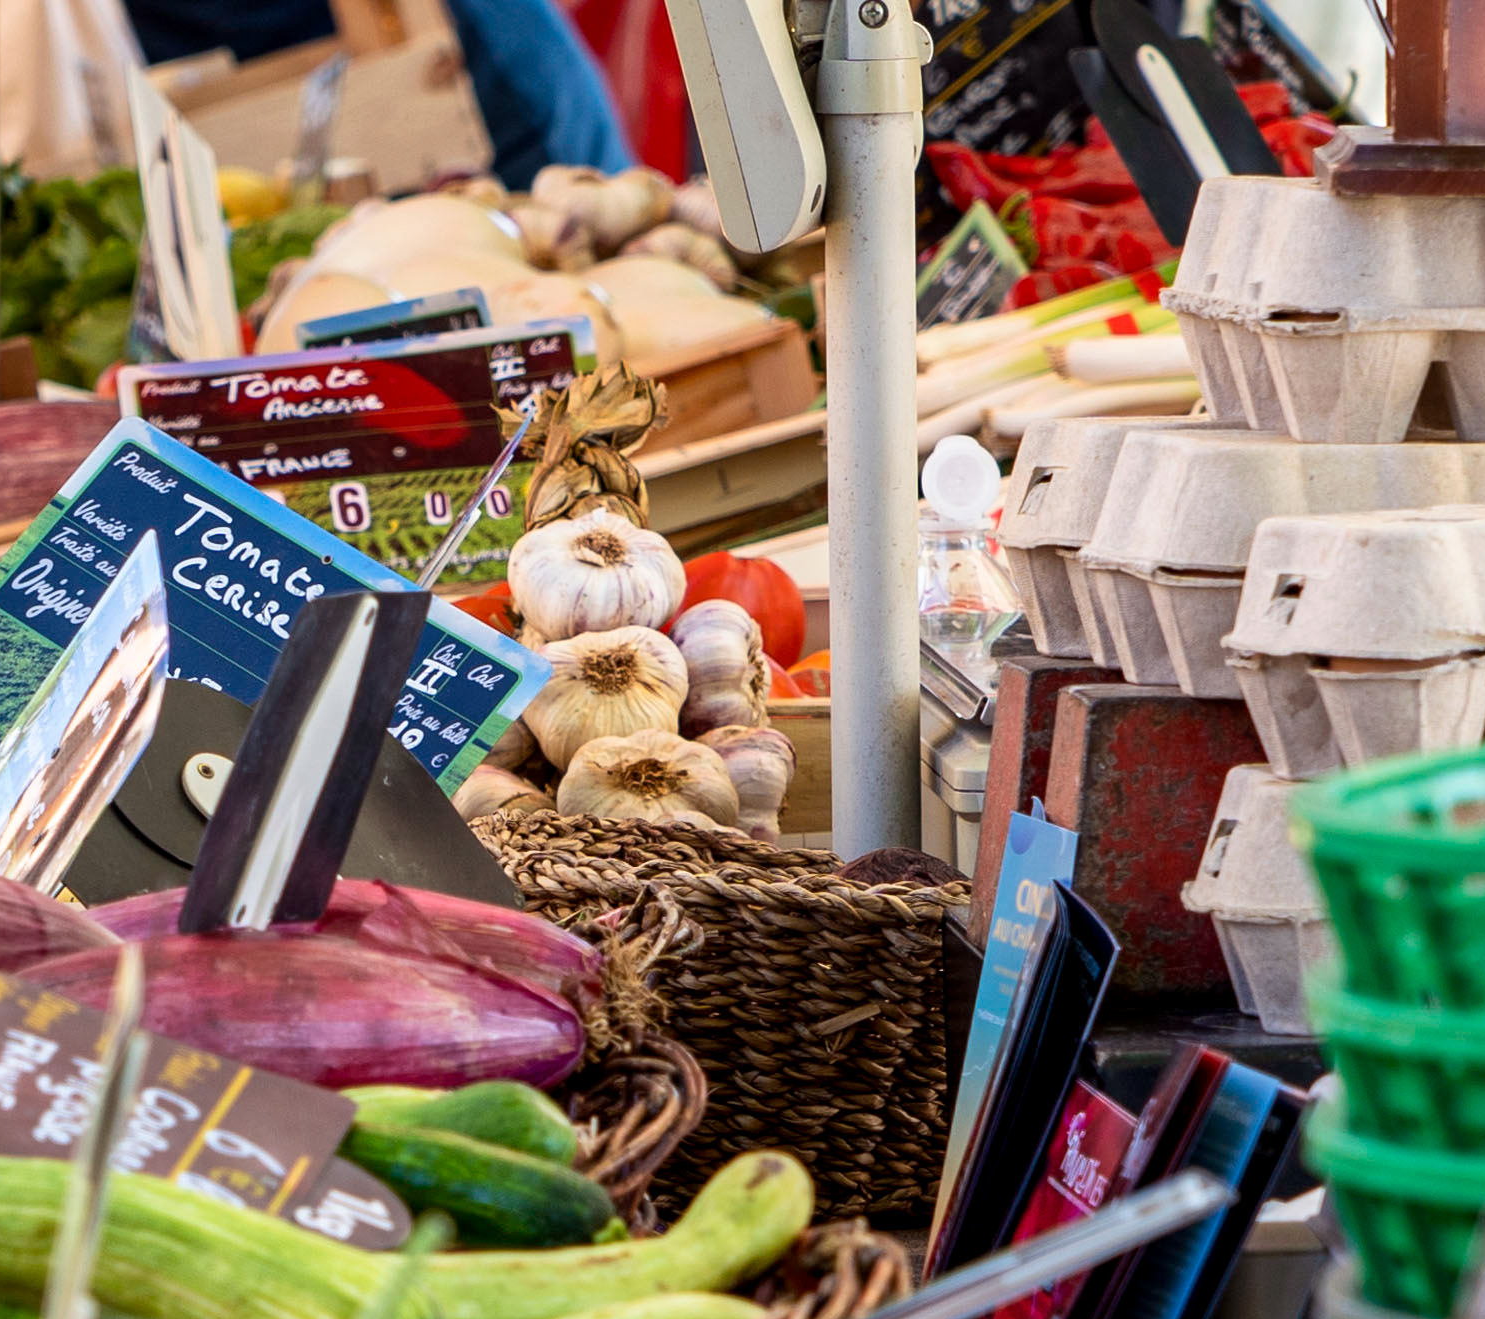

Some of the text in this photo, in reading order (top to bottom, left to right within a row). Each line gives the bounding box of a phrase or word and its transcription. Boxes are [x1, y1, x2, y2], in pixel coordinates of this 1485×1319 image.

[208, 366, 370, 404] Tomate
[263, 394, 385, 421] Ancienne
[238, 447, 353, 480] FRANCE
[113, 451, 326, 603] Produit Tomate
[50, 526, 118, 579] Traité au
[73, 499, 133, 542] Variété
[172, 557, 291, 640] Cerise
[10, 557, 95, 626] Origine
[405, 658, 458, 696] II
[433, 643, 505, 691] Cat. Cal.
[395, 693, 470, 746] Prix au kilo
[431, 753, 449, 768] €
